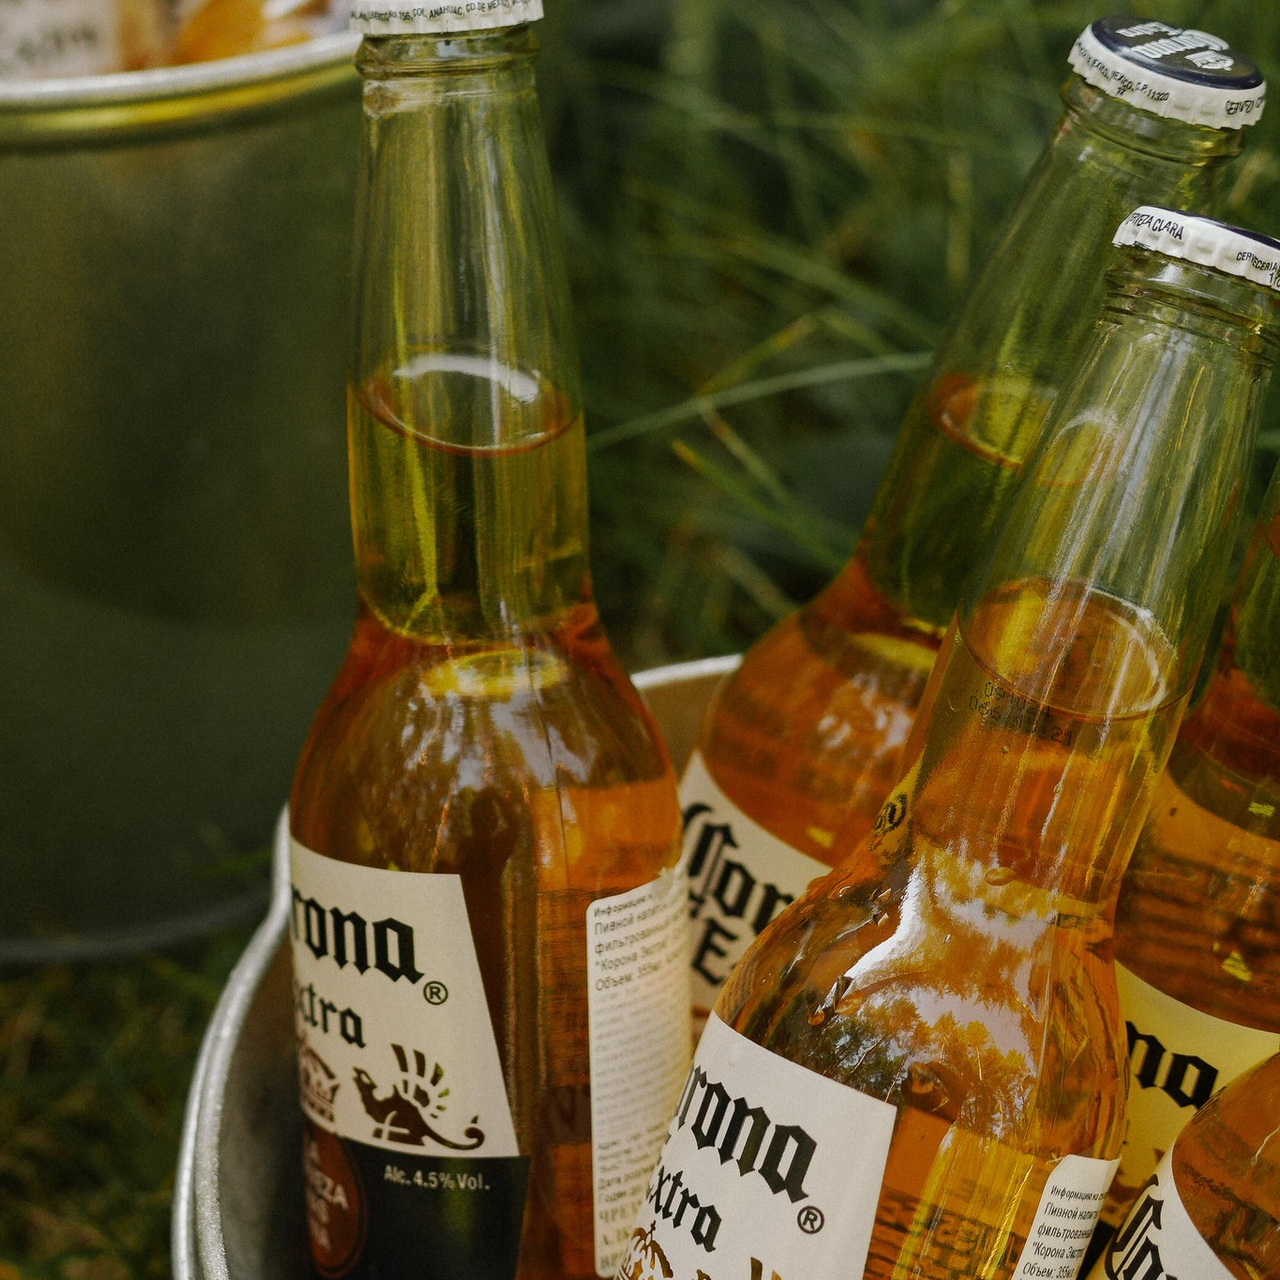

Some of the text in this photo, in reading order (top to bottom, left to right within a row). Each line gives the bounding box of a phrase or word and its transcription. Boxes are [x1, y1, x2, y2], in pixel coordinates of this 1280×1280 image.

[1152, 218, 1184, 240] CLARA
[412, 1171, 455, 1190] 4.5%
[456, 1172, 491, 1191] Vol.
[1044, 1201, 1079, 1219] Пивной
